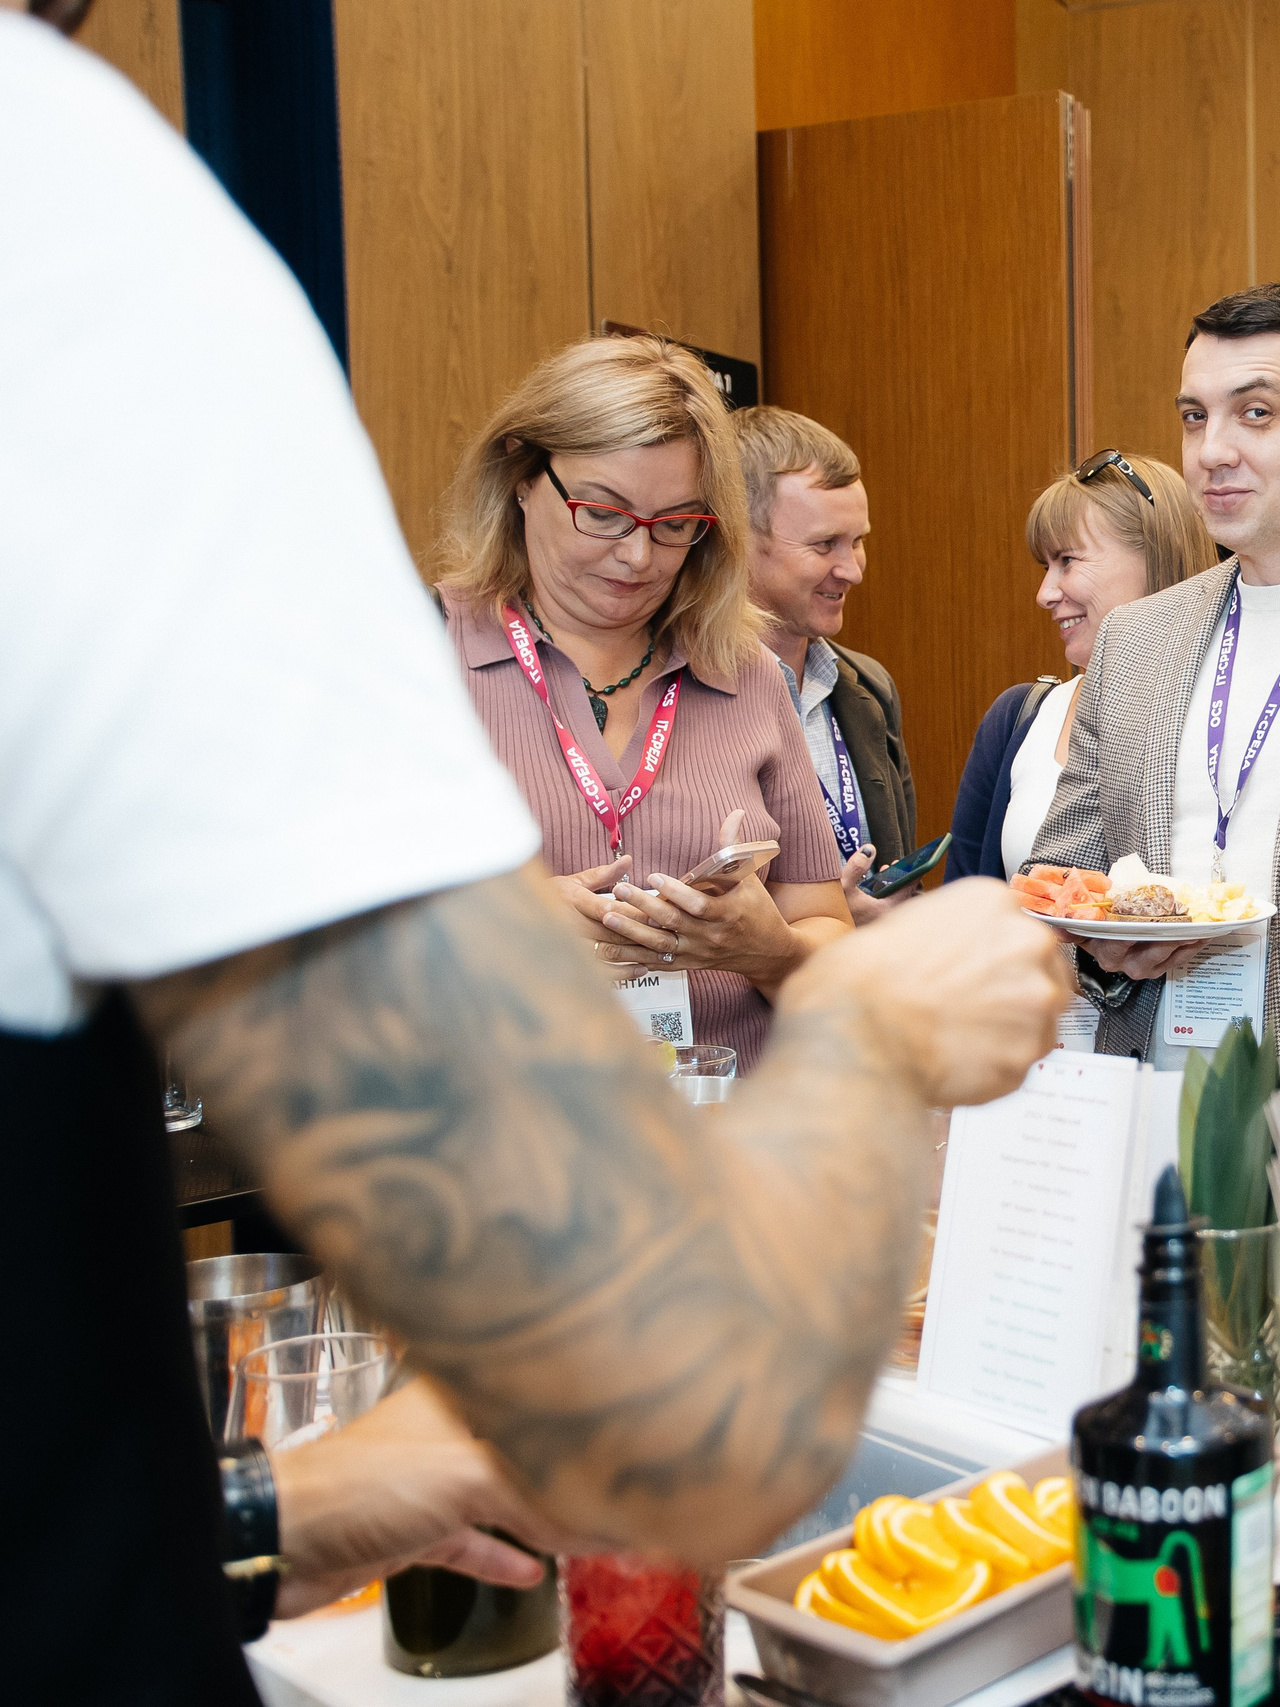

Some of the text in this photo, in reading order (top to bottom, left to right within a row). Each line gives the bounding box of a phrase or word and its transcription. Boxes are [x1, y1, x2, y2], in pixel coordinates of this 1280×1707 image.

[1216, 627, 1235, 686] IT-СРЕДА
[509, 620, 609, 815] IT-СРЕДА IT-СРЕДА
[1210, 699, 1223, 728] OCS
[1242, 703, 1277, 771] IT-СРЕДА
[619, 683, 678, 816] OCS IT-СРЕДА OCS
[838, 754, 856, 813] IT-СРЕДА
[826, 797, 853, 853] IT-СРЕДА
